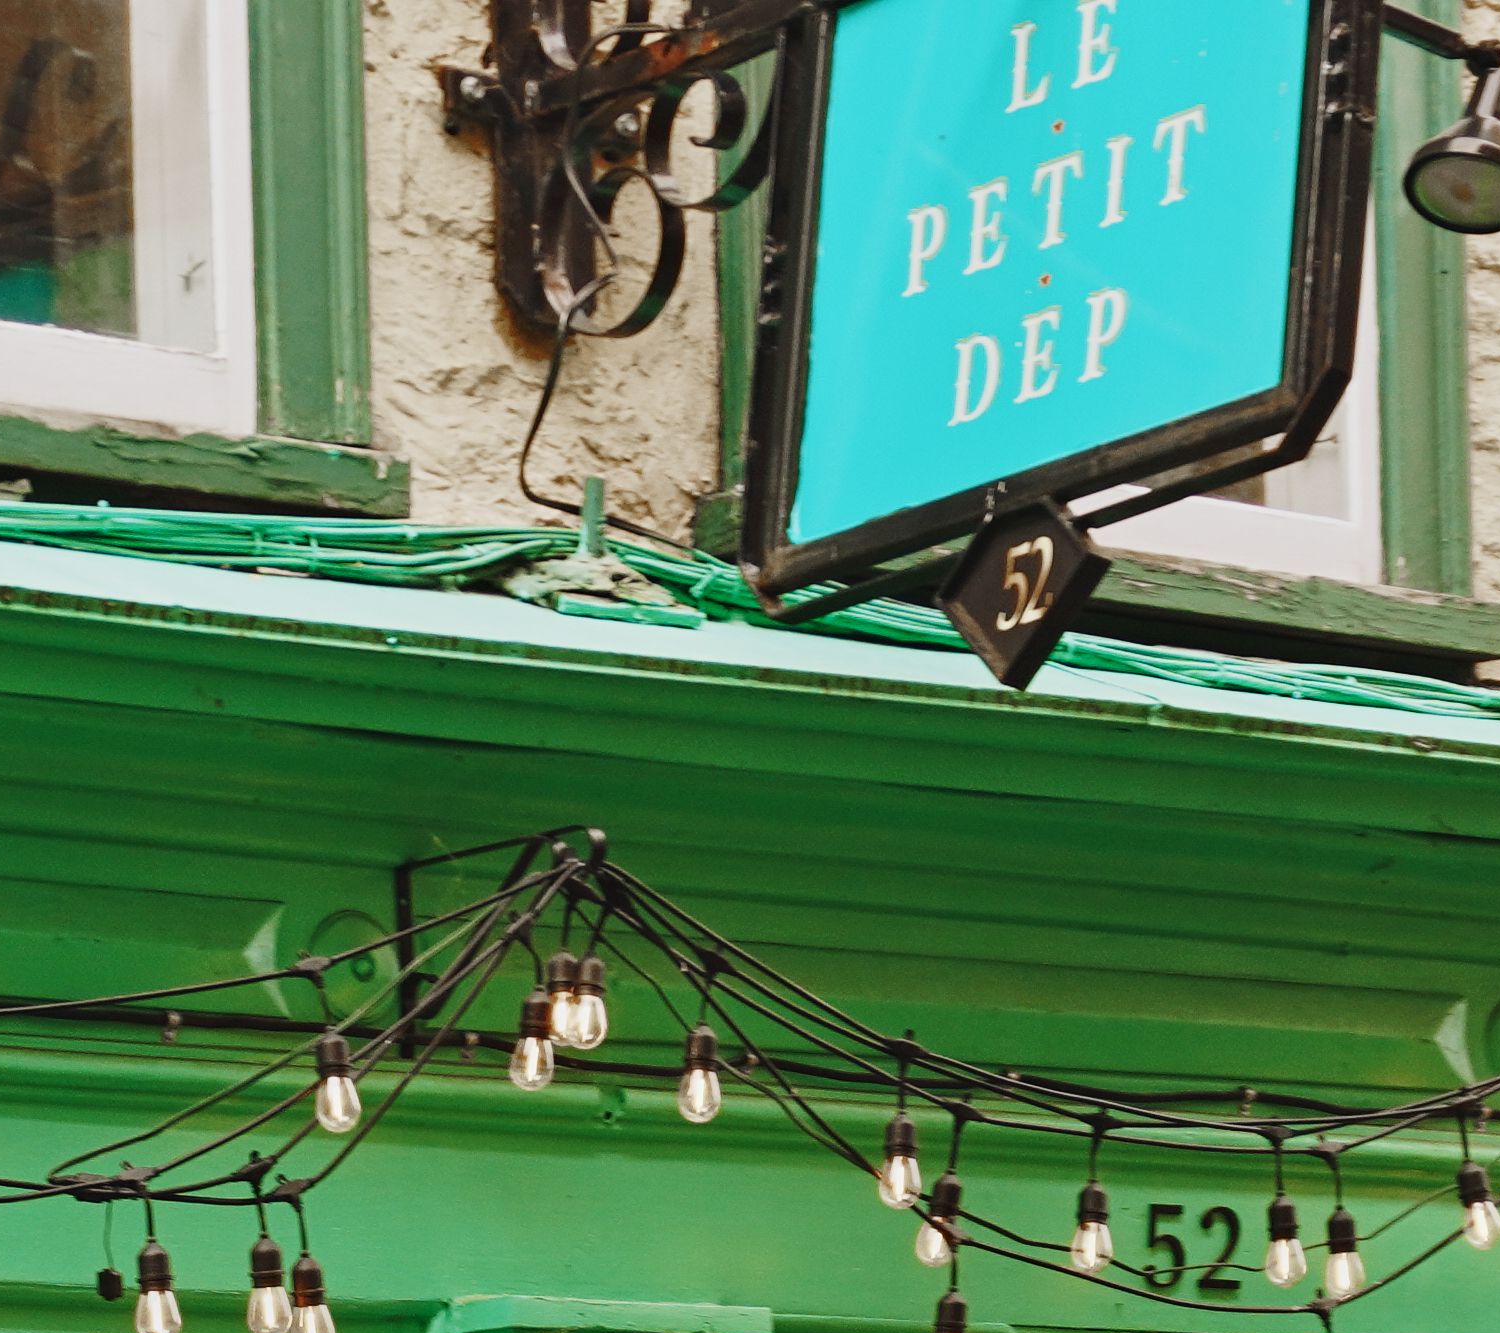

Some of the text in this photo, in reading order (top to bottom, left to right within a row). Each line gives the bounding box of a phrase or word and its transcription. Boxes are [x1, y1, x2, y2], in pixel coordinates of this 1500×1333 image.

[1005, 0, 1120, 113] LE
[901, 104, 1208, 298] PETIT
[947, 288, 1128, 427] DEP
[996, 535, 1054, 632] 52
[1143, 1203, 1241, 1290] 52
